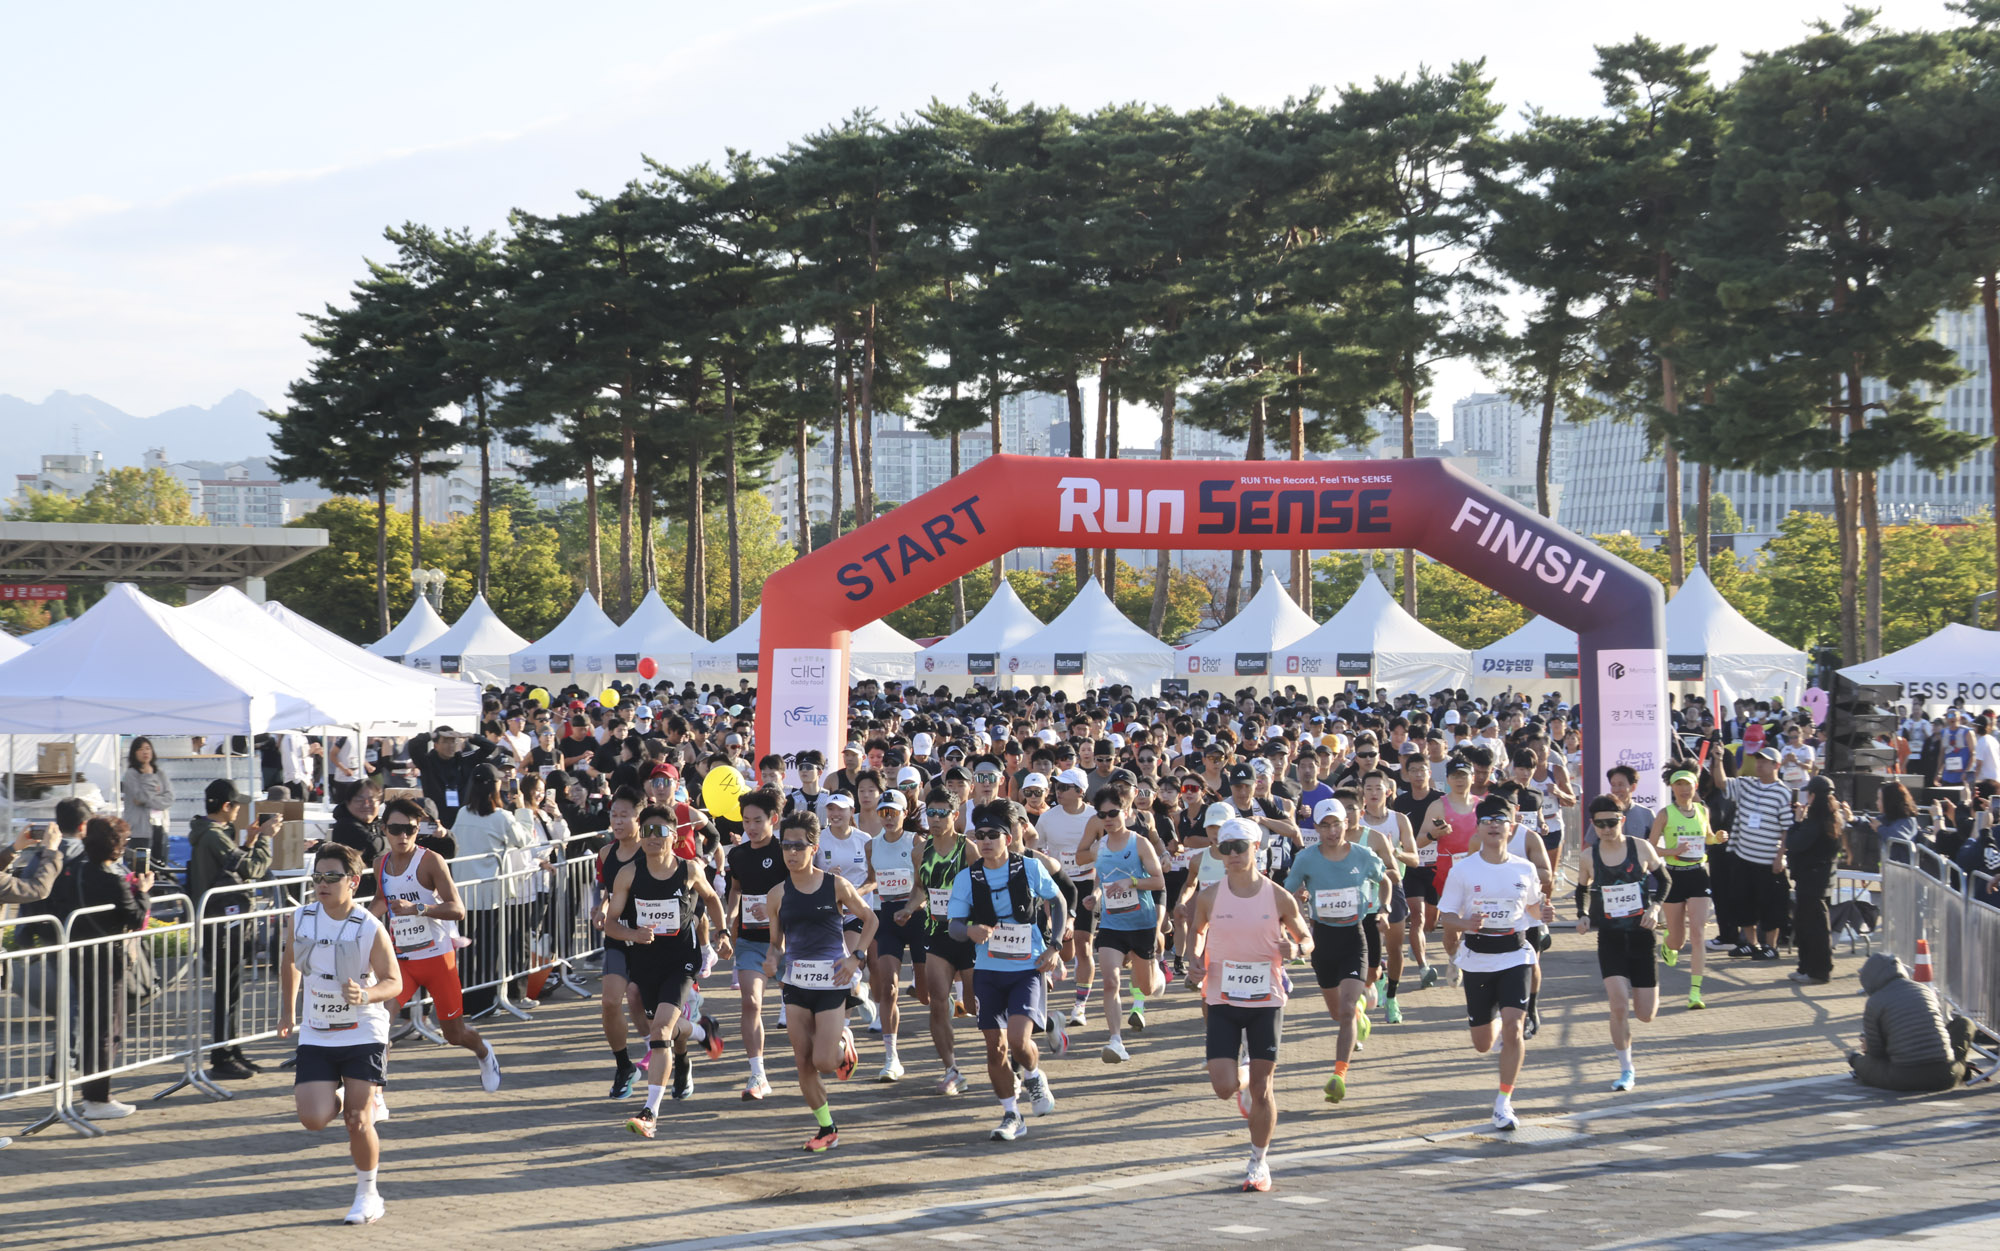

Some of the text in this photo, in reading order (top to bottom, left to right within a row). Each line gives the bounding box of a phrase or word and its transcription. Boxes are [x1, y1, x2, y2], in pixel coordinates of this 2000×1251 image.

[1240, 475, 1392, 485] RUN The Record, Feel The SENSE
[836, 495, 986, 602] START
[1450, 496, 1606, 604] FINISH
[1202, 656, 1221, 666] Short
[1302, 656, 1321, 666] Short
[791, 665, 825, 678] 대디
[1611, 710, 1655, 722] 경기떡집
[1619, 748, 1653, 760] Choco
[886, 879, 907, 887] 2210
[1614, 894, 1636, 904] 1450
[649, 912, 674, 920] 1095
[402, 925, 424, 936] 1199
[1003, 935, 1026, 944] 1411
[1238, 975, 1264, 984] 1061
[320, 1004, 350, 1012] 1234
